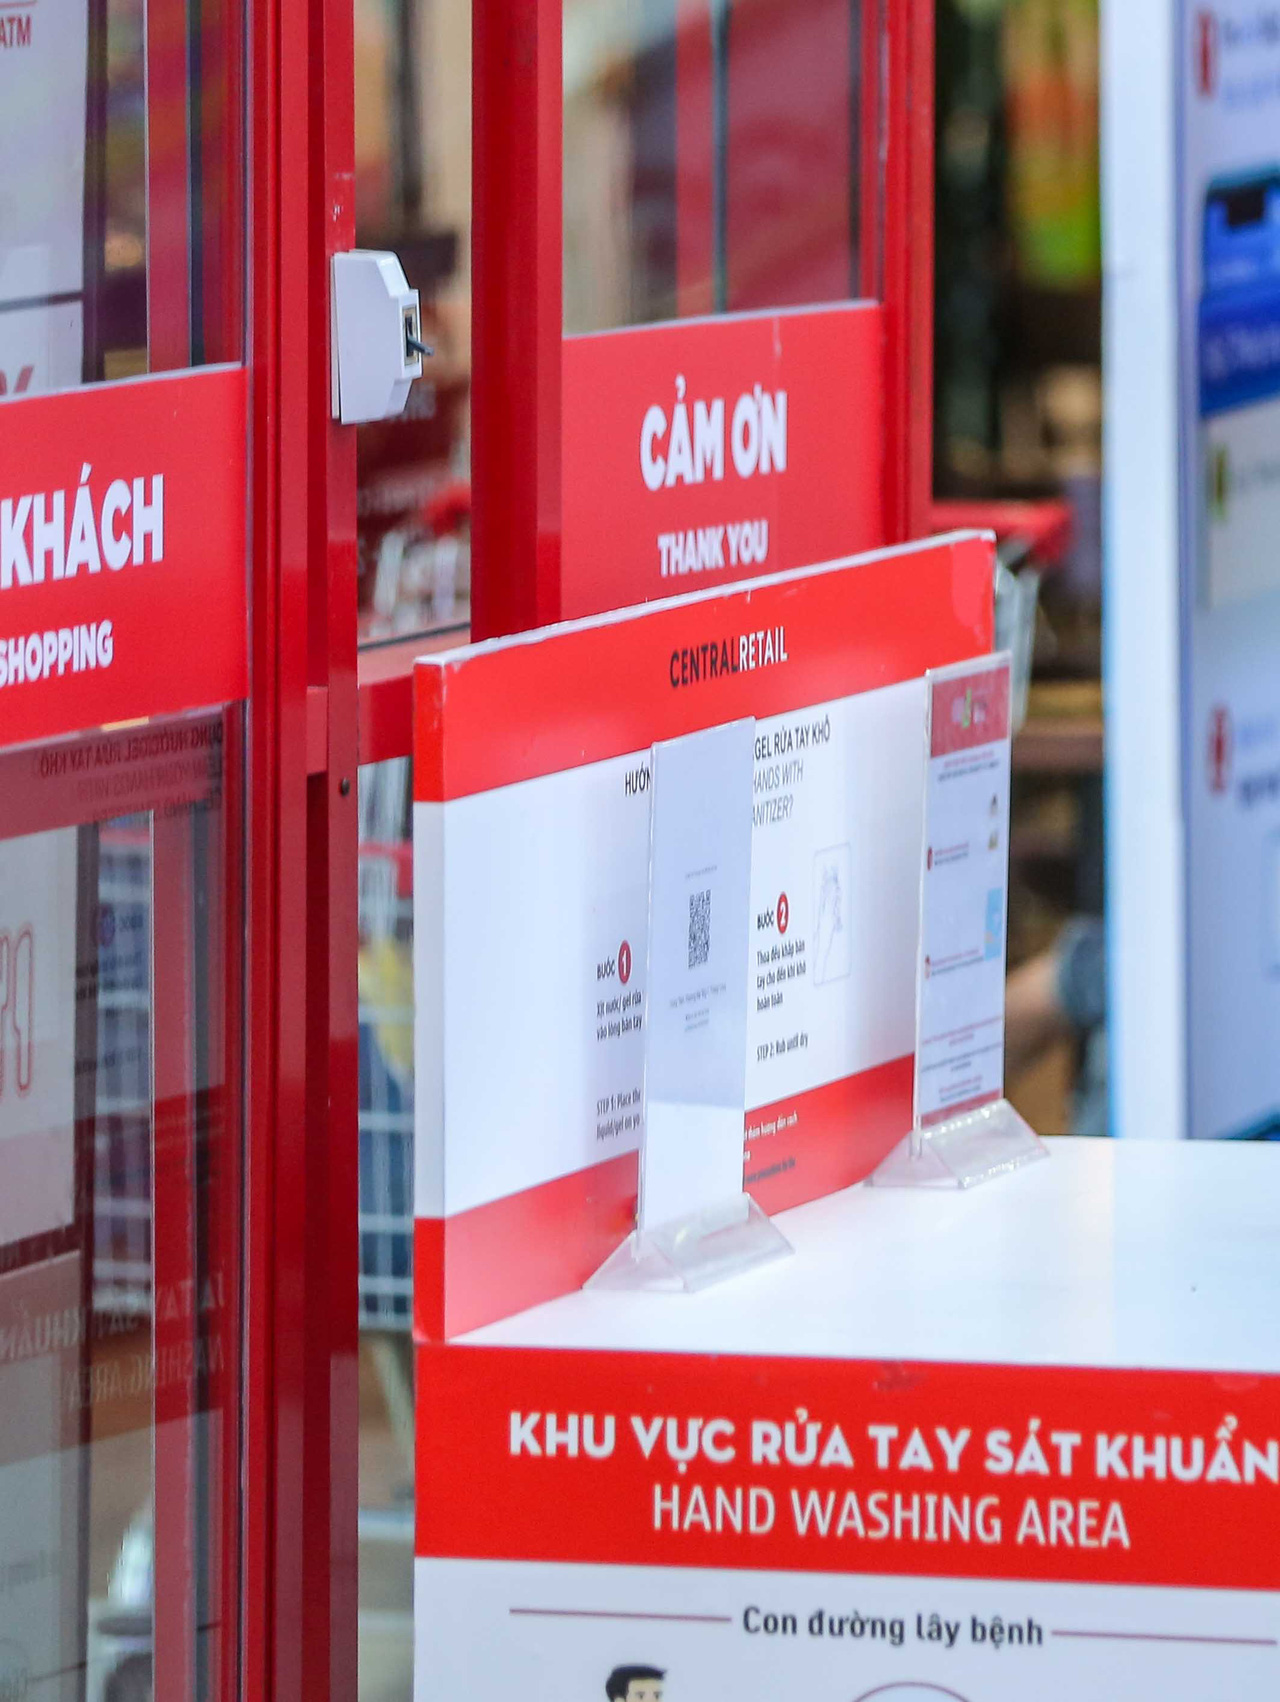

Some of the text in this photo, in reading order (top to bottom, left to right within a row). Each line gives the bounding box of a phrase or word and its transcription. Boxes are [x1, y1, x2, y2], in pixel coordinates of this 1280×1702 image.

[639, 372, 788, 491] CẢM ƠN
[0, 461, 164, 590] KHÁCH
[657, 517, 769, 578] THANK YOU
[0, 618, 114, 688] SHOPPING
[754, 714, 831, 760] GEL RỬA TAY KHÔ
[782, 759, 804, 785] WITH
[633, 1014, 642, 1031] tay
[757, 1043, 769, 1062] STEP
[509, 1407, 1280, 1484] KHU VỰC RỬA TAY SÁT KHUẨN
[652, 1483, 1132, 1549] HAND WASHING AREA
[743, 1606, 1043, 1650] Con đường lây bệnh
